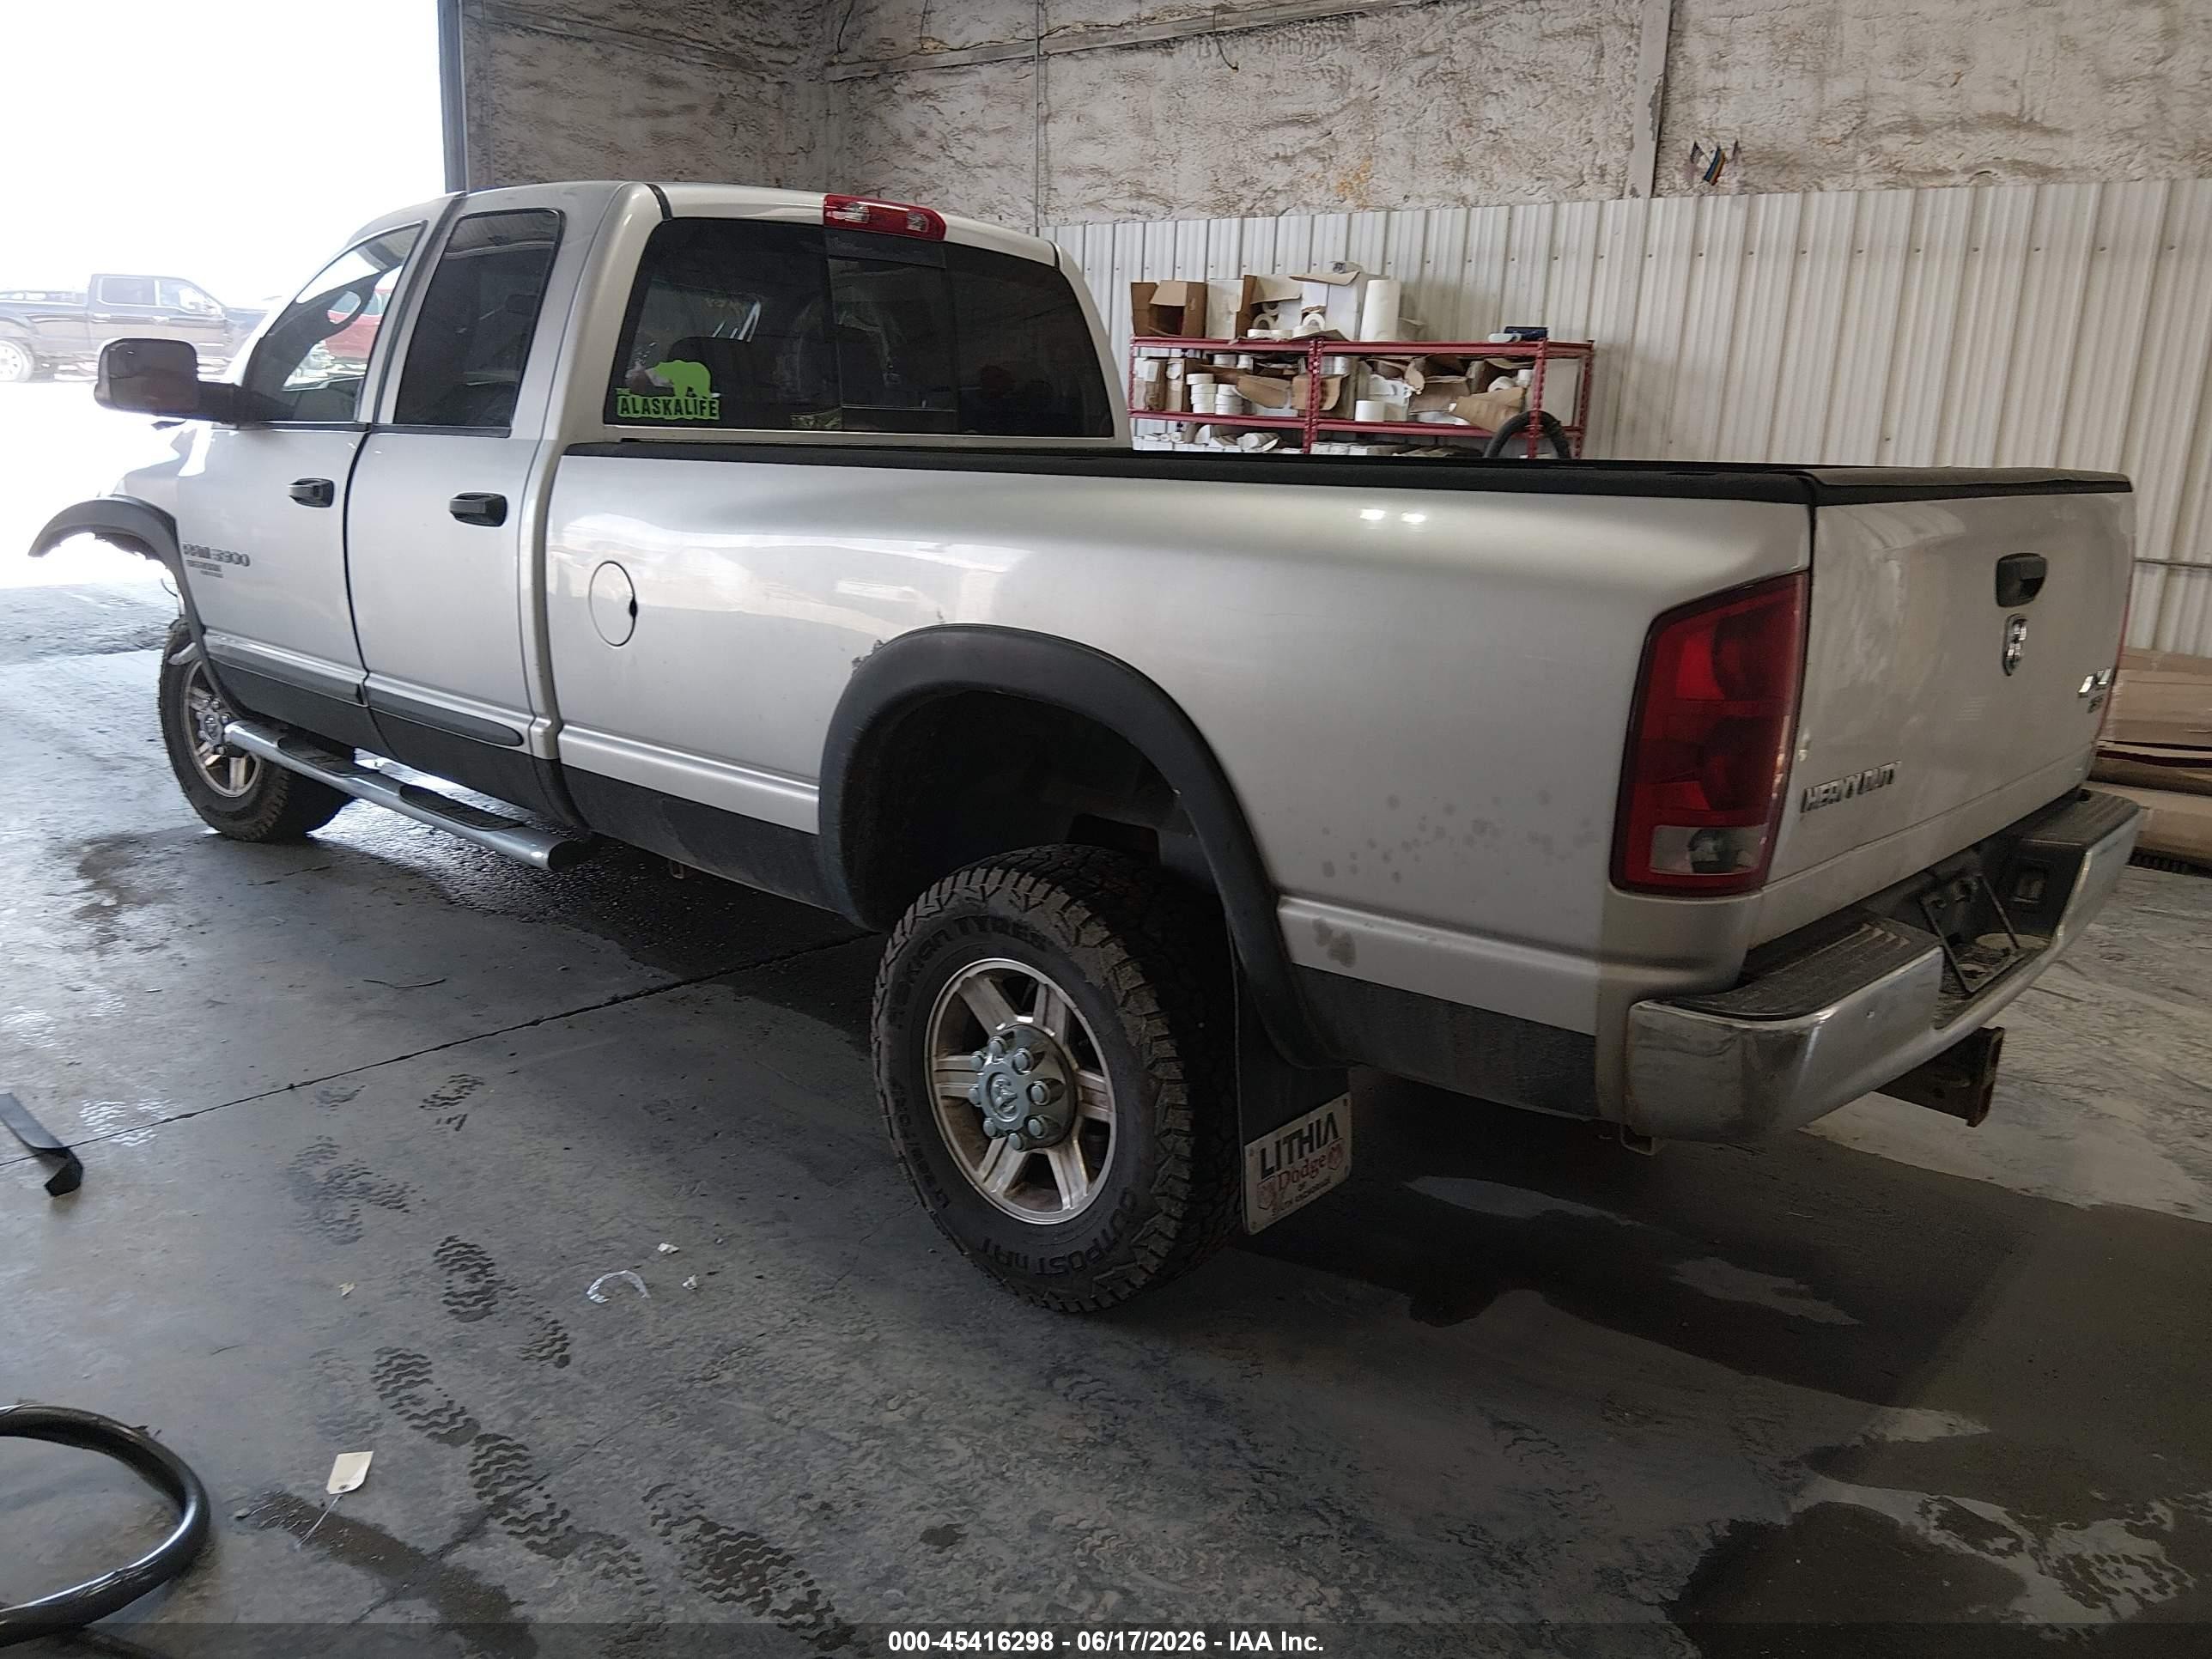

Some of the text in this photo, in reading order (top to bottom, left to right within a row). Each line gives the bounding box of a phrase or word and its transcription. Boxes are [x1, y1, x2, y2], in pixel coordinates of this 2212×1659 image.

[620, 398, 718, 417] ALASKALIFE
[1260, 1112, 1340, 1179] LITHIA
[1278, 1154, 1327, 1191] Dodge
